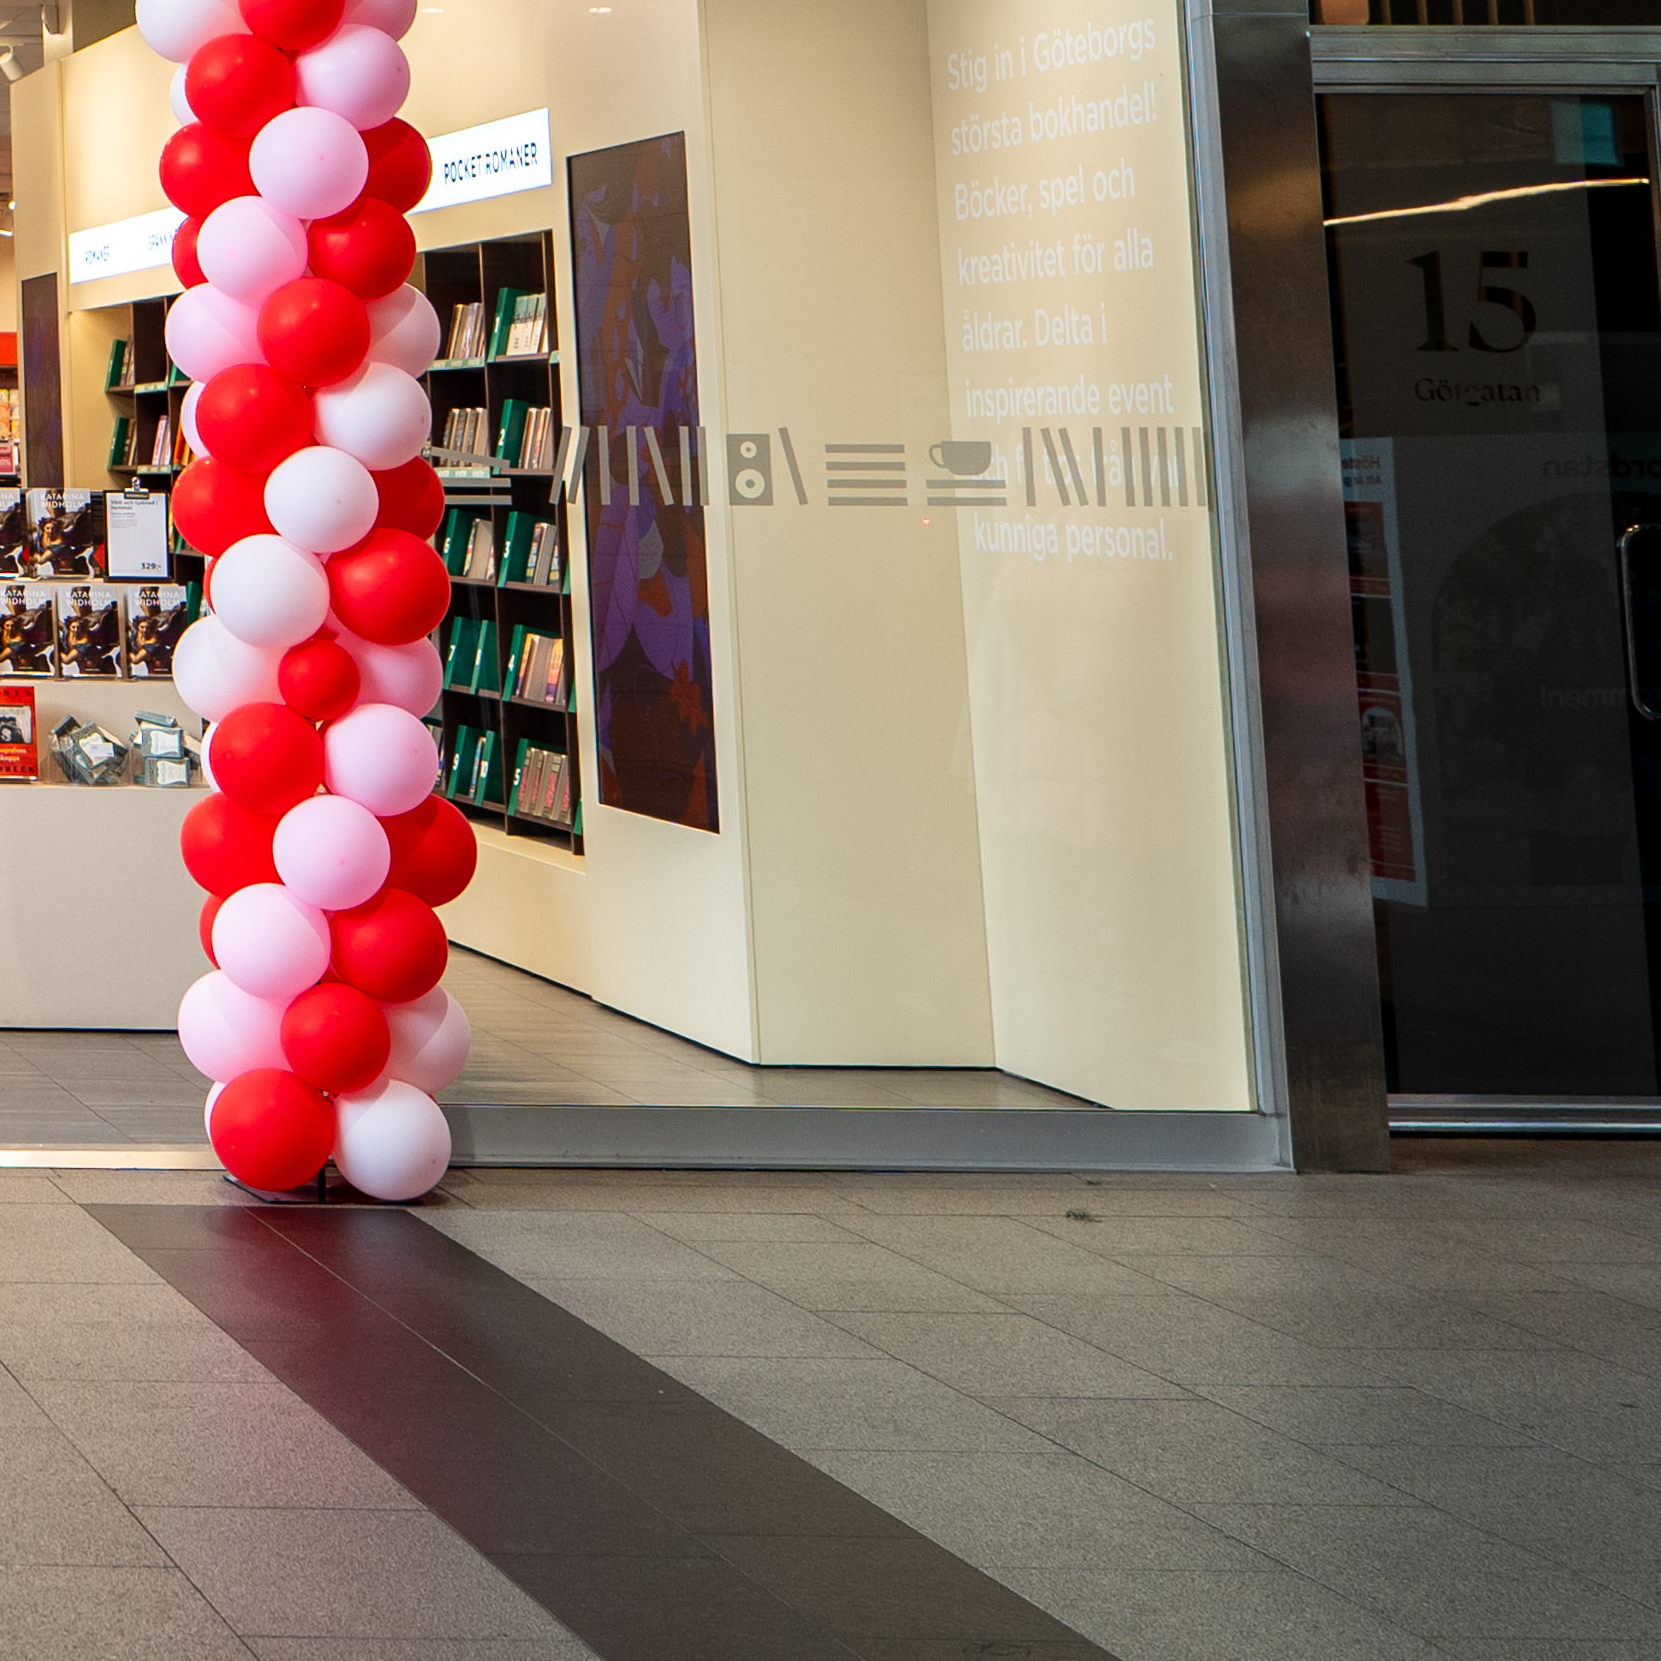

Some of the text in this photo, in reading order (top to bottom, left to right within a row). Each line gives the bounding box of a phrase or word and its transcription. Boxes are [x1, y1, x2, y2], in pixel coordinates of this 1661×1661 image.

[947, 18, 1157, 94] Stig in i Göteborgs
[951, 81, 1158, 156] största bokhandel!
[444, 142, 538, 185] POCKET ROMANER
[955, 156, 1136, 221] Böcker, spel och
[957, 227, 1155, 286] kreativitet för alla
[962, 302, 1107, 352] åldrar. Delta i
[1404, 249, 1537, 354] 15
[965, 374, 1175, 425] inspirerande event
[39, 493, 86, 501] KATARINA
[973, 511, 1174, 563] kunniga personal.
[141, 561, 162, 570] 329:-
